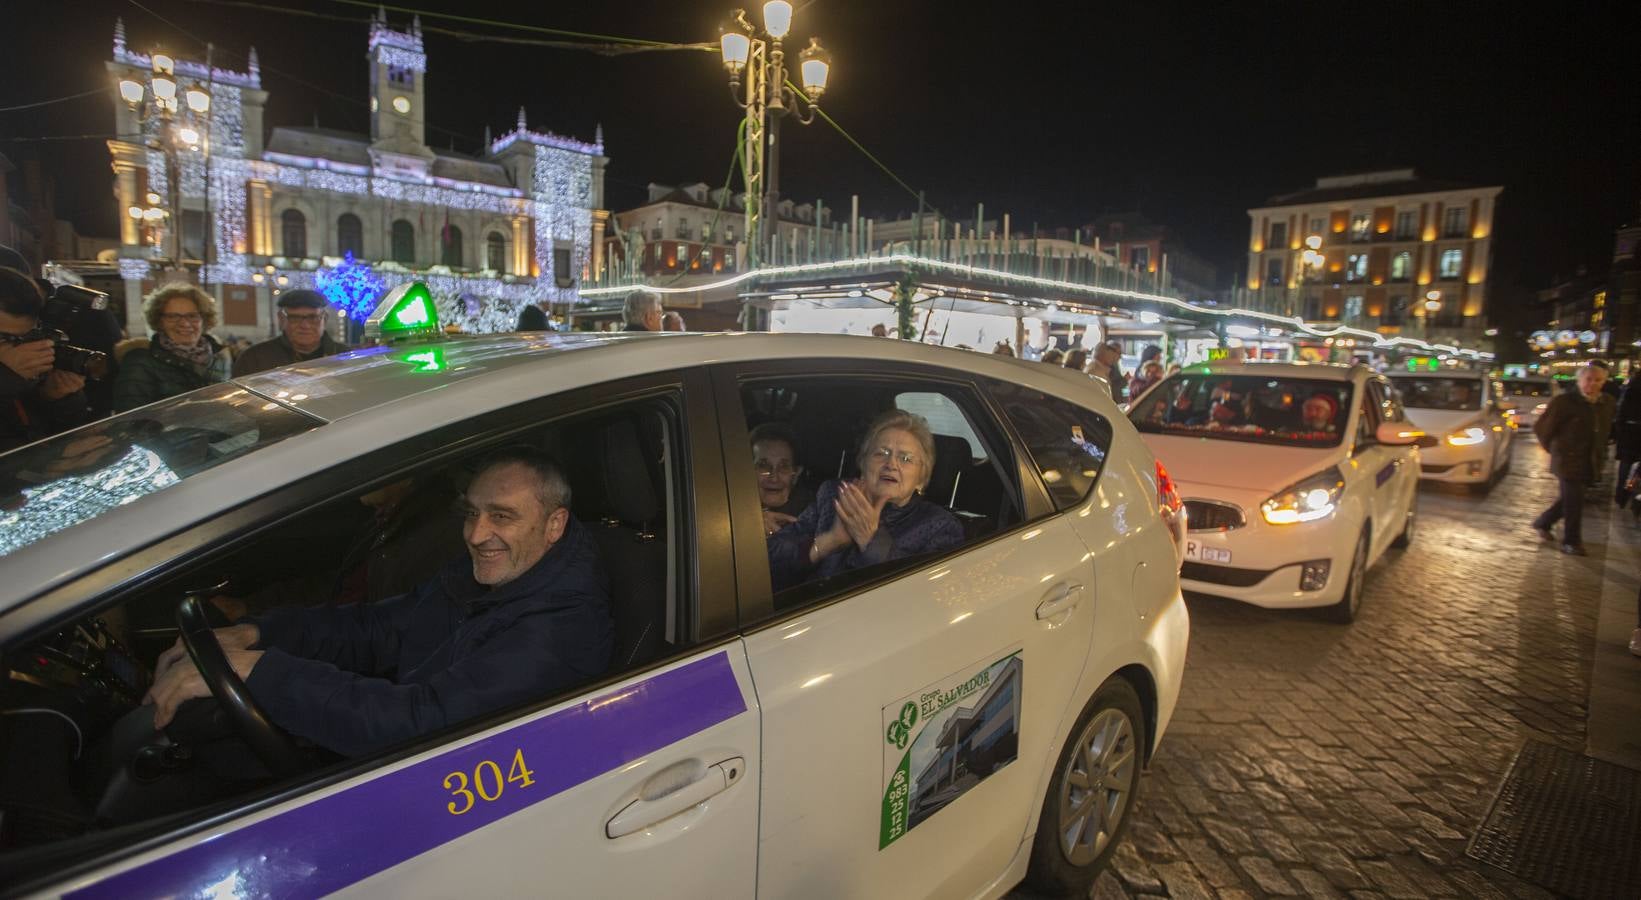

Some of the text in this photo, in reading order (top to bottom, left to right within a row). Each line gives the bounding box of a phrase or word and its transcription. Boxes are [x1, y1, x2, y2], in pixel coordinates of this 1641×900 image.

[920, 689, 941, 703] Grupo
[921, 700, 936, 716] EL
[937, 671, 990, 708] SALVADOR
[443, 748, 535, 815] 304
[889, 783, 908, 803] 983
[891, 798, 904, 814] 25
[892, 811, 902, 826] 12
[889, 823, 902, 840] 25
